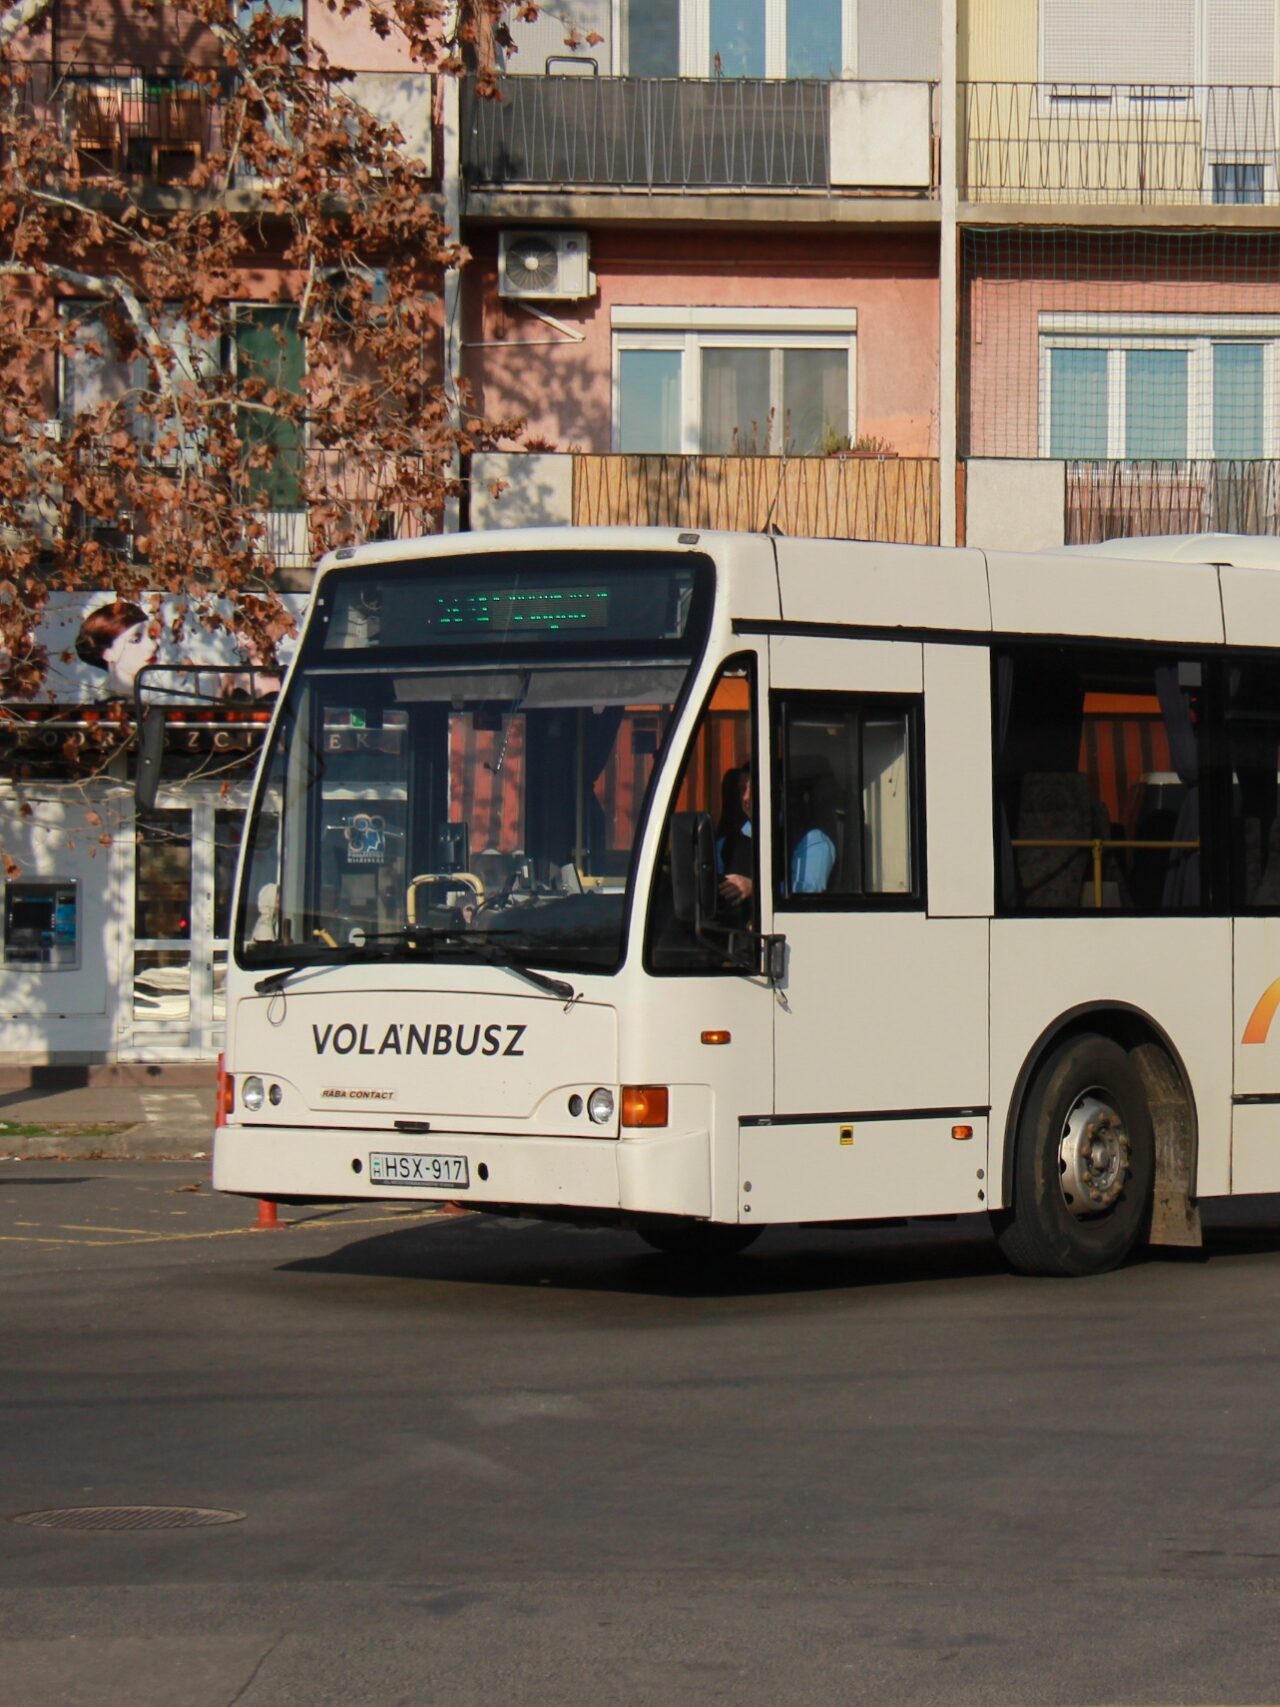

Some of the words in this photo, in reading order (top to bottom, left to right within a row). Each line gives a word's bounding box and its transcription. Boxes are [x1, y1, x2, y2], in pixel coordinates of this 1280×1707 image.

[312, 1023, 528, 1056] VOLÁNBUSZ
[349, 1090, 394, 1100] CONTACT
[385, 1157, 462, 1180] HSX-917
